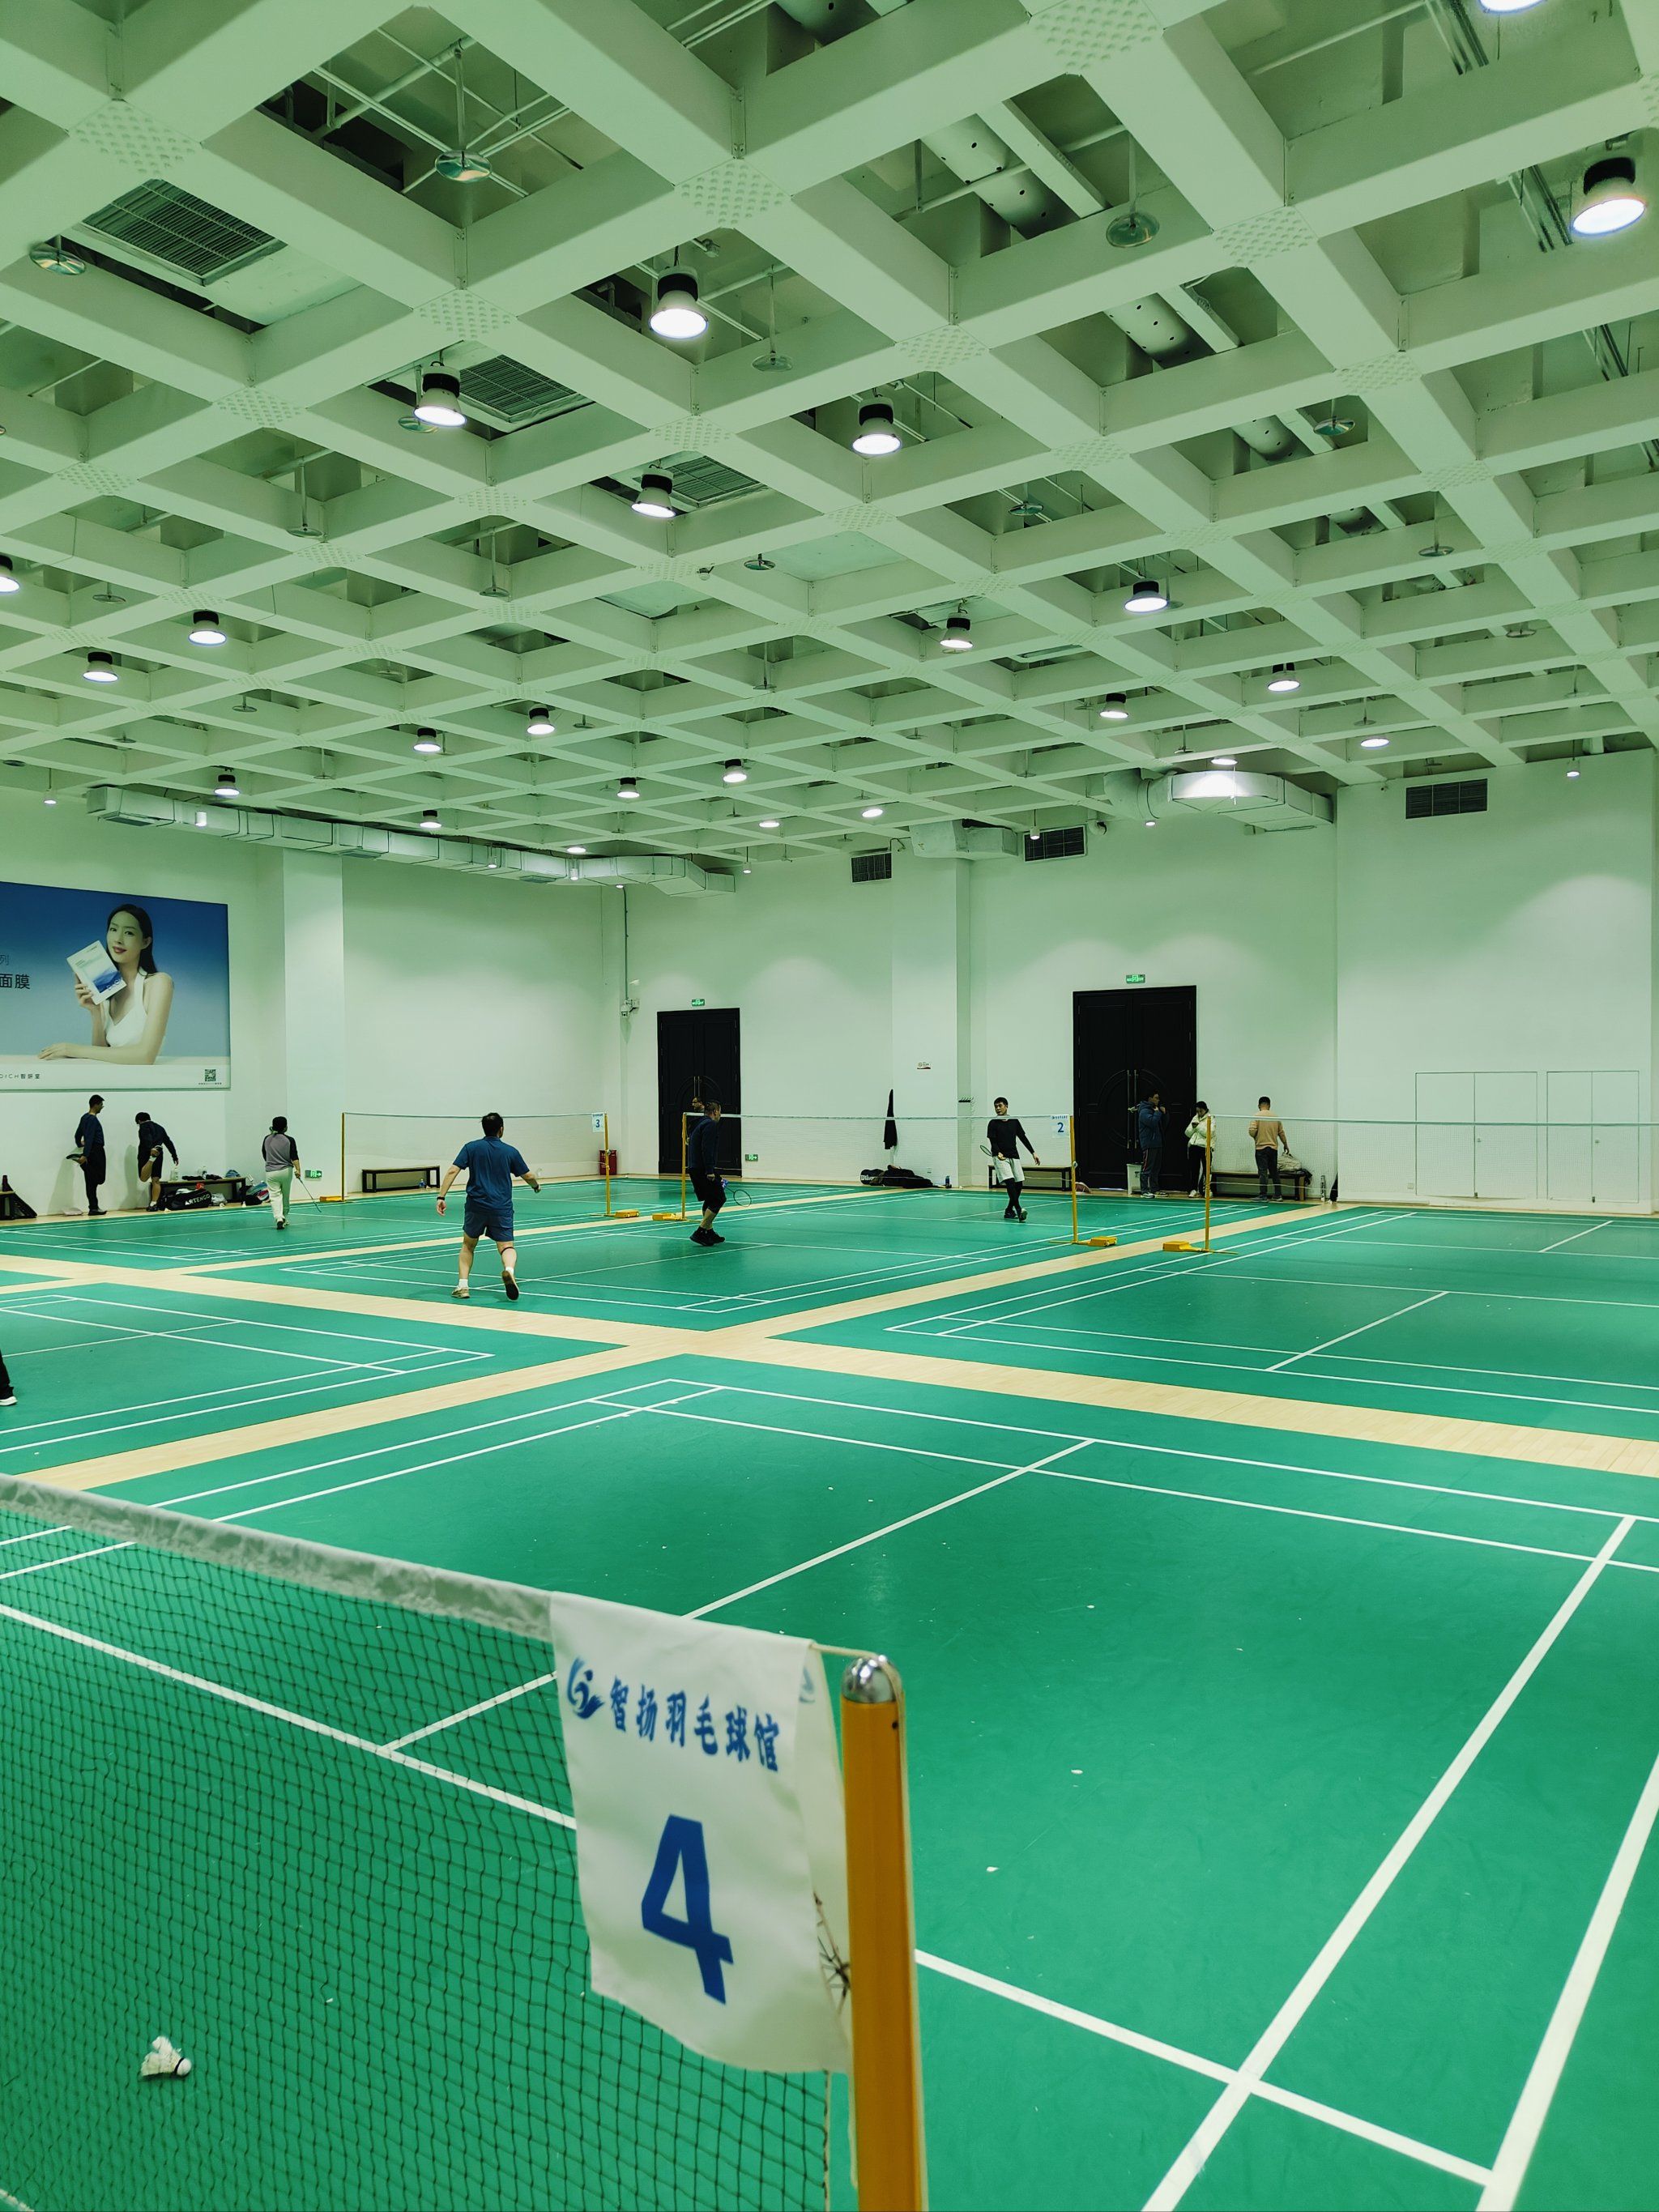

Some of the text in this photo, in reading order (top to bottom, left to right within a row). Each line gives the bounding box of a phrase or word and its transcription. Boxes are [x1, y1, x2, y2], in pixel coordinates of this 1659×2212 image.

[0, 973, 30, 989] 面膜
[595, 1119, 600, 1128] 3
[1057, 1122, 1064, 1133] 2
[185, 1193, 211, 1206] ARTENGO
[610, 1676, 779, 1772] 智扬羽毛球馆
[641, 1813, 734, 2005] 4
